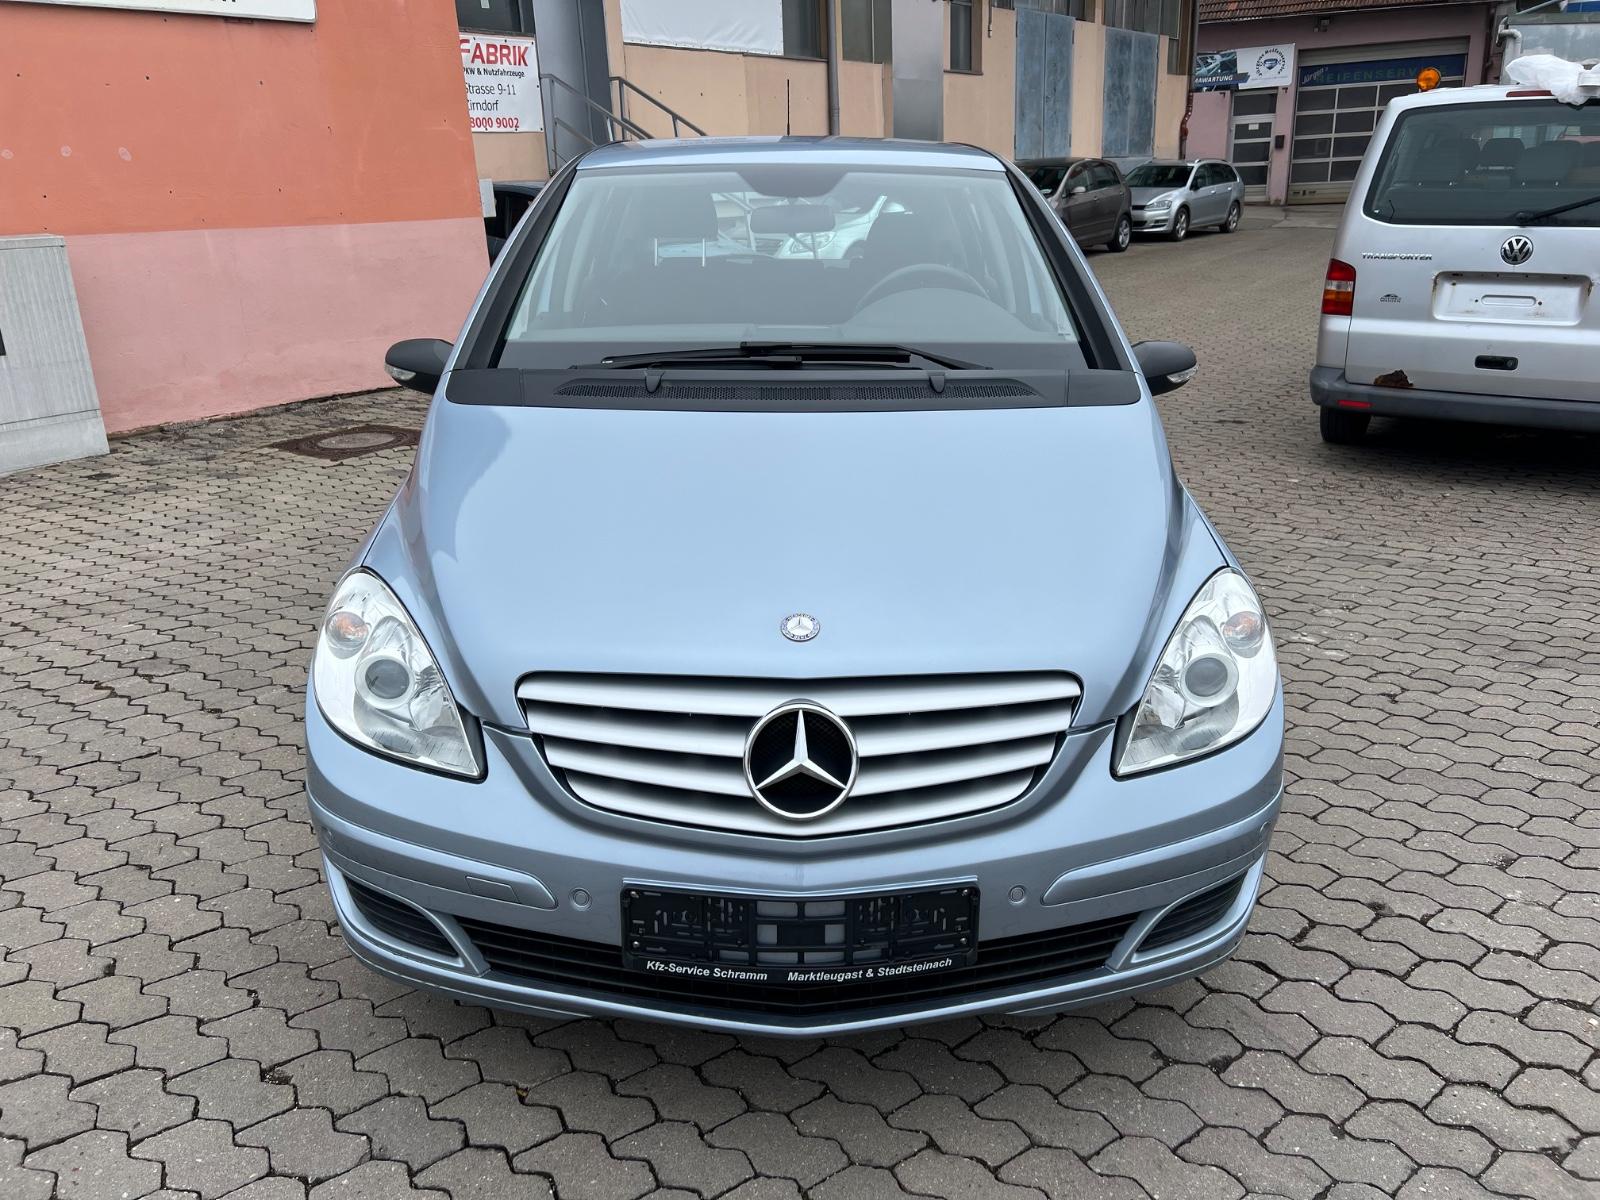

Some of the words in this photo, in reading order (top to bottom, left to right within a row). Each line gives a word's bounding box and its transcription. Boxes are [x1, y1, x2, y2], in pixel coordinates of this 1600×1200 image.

[484, 68, 525, 78] Nutzfahrzeuge
[498, 84, 517, 96] 9-11
[467, 99, 499, 111] irndorf
[495, 117, 520, 128] 9002
[1362, 252, 1433, 261] TRANSPORTER
[646, 960, 710, 976] Kfz-Service
[713, 968, 768, 981] Schramm
[787, 971, 863, 982] Marktleugast
[866, 968, 874, 978] &
[877, 957, 952, 976] Stadtsteinach
